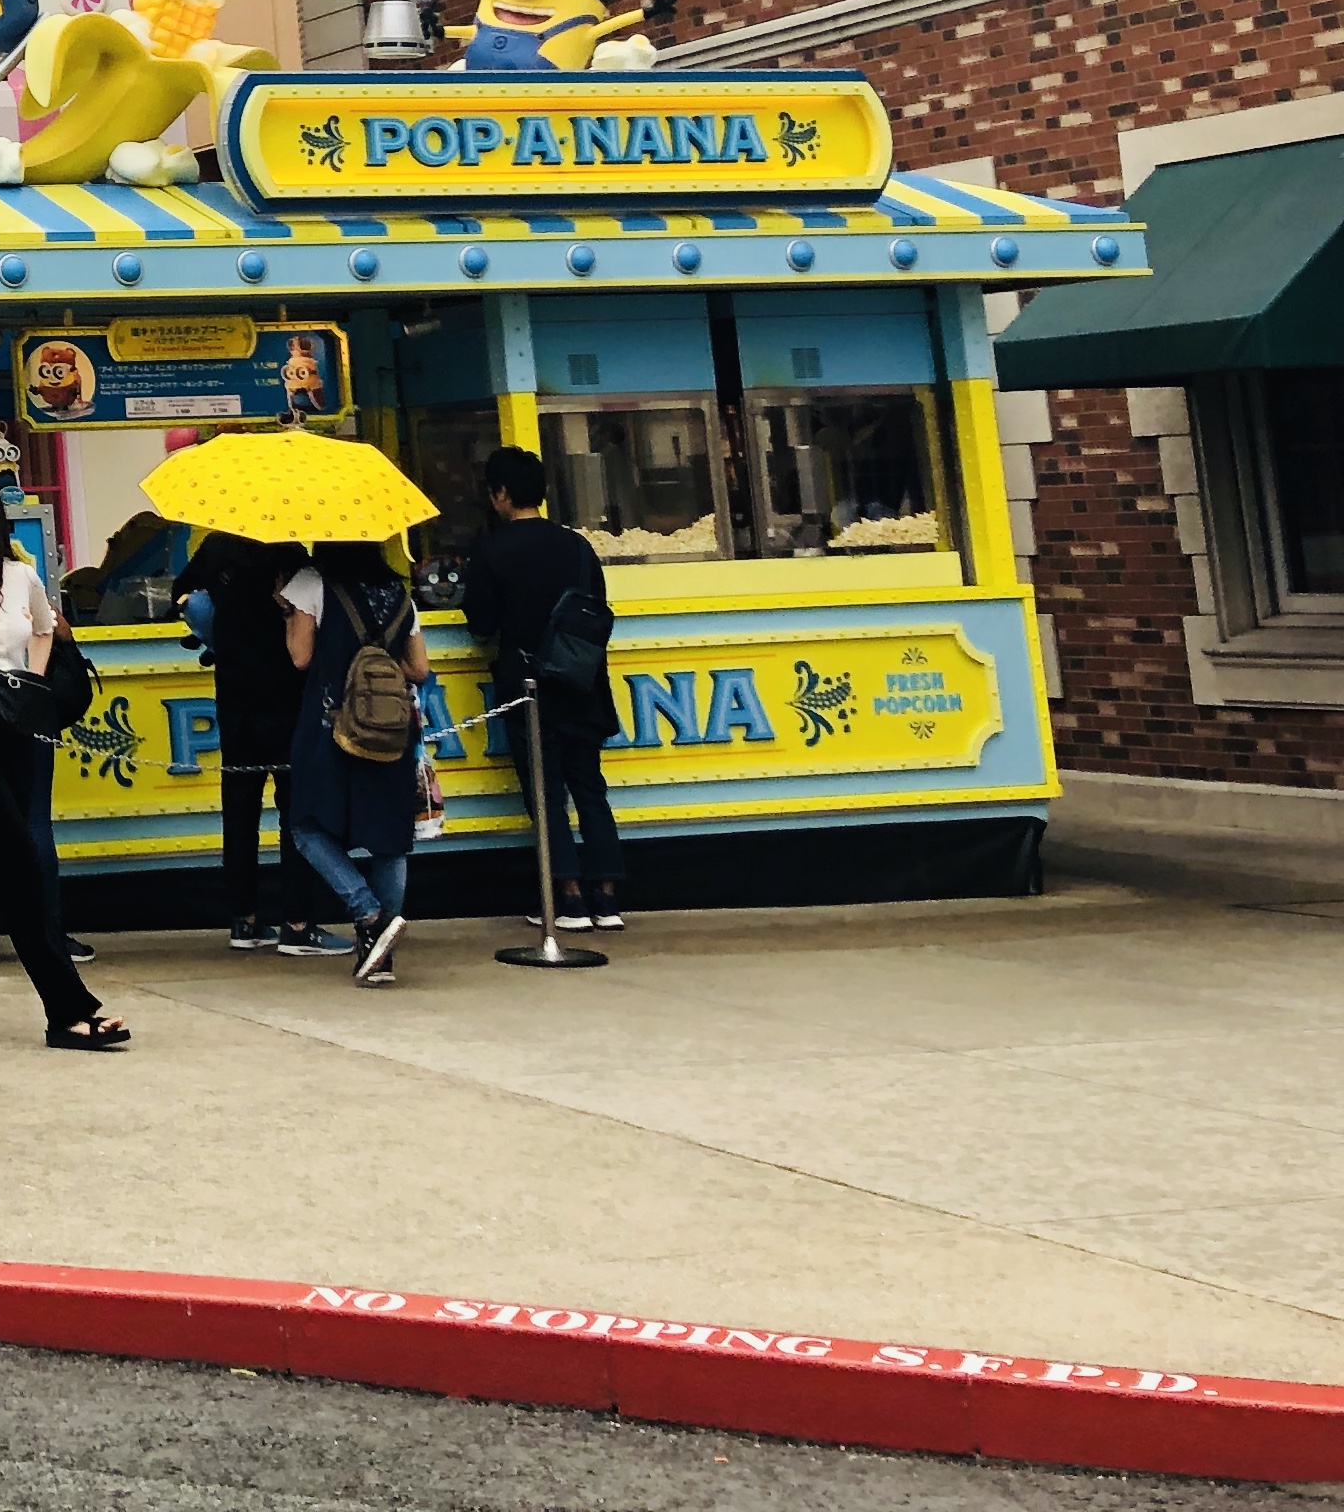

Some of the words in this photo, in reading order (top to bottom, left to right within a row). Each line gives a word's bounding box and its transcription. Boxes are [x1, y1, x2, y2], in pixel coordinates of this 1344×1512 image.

[886, 671, 945, 693] FRESH
[873, 693, 963, 716] POPCORN
[297, 1285, 408, 1313] NO
[433, 1299, 835, 1358] STOPPING
